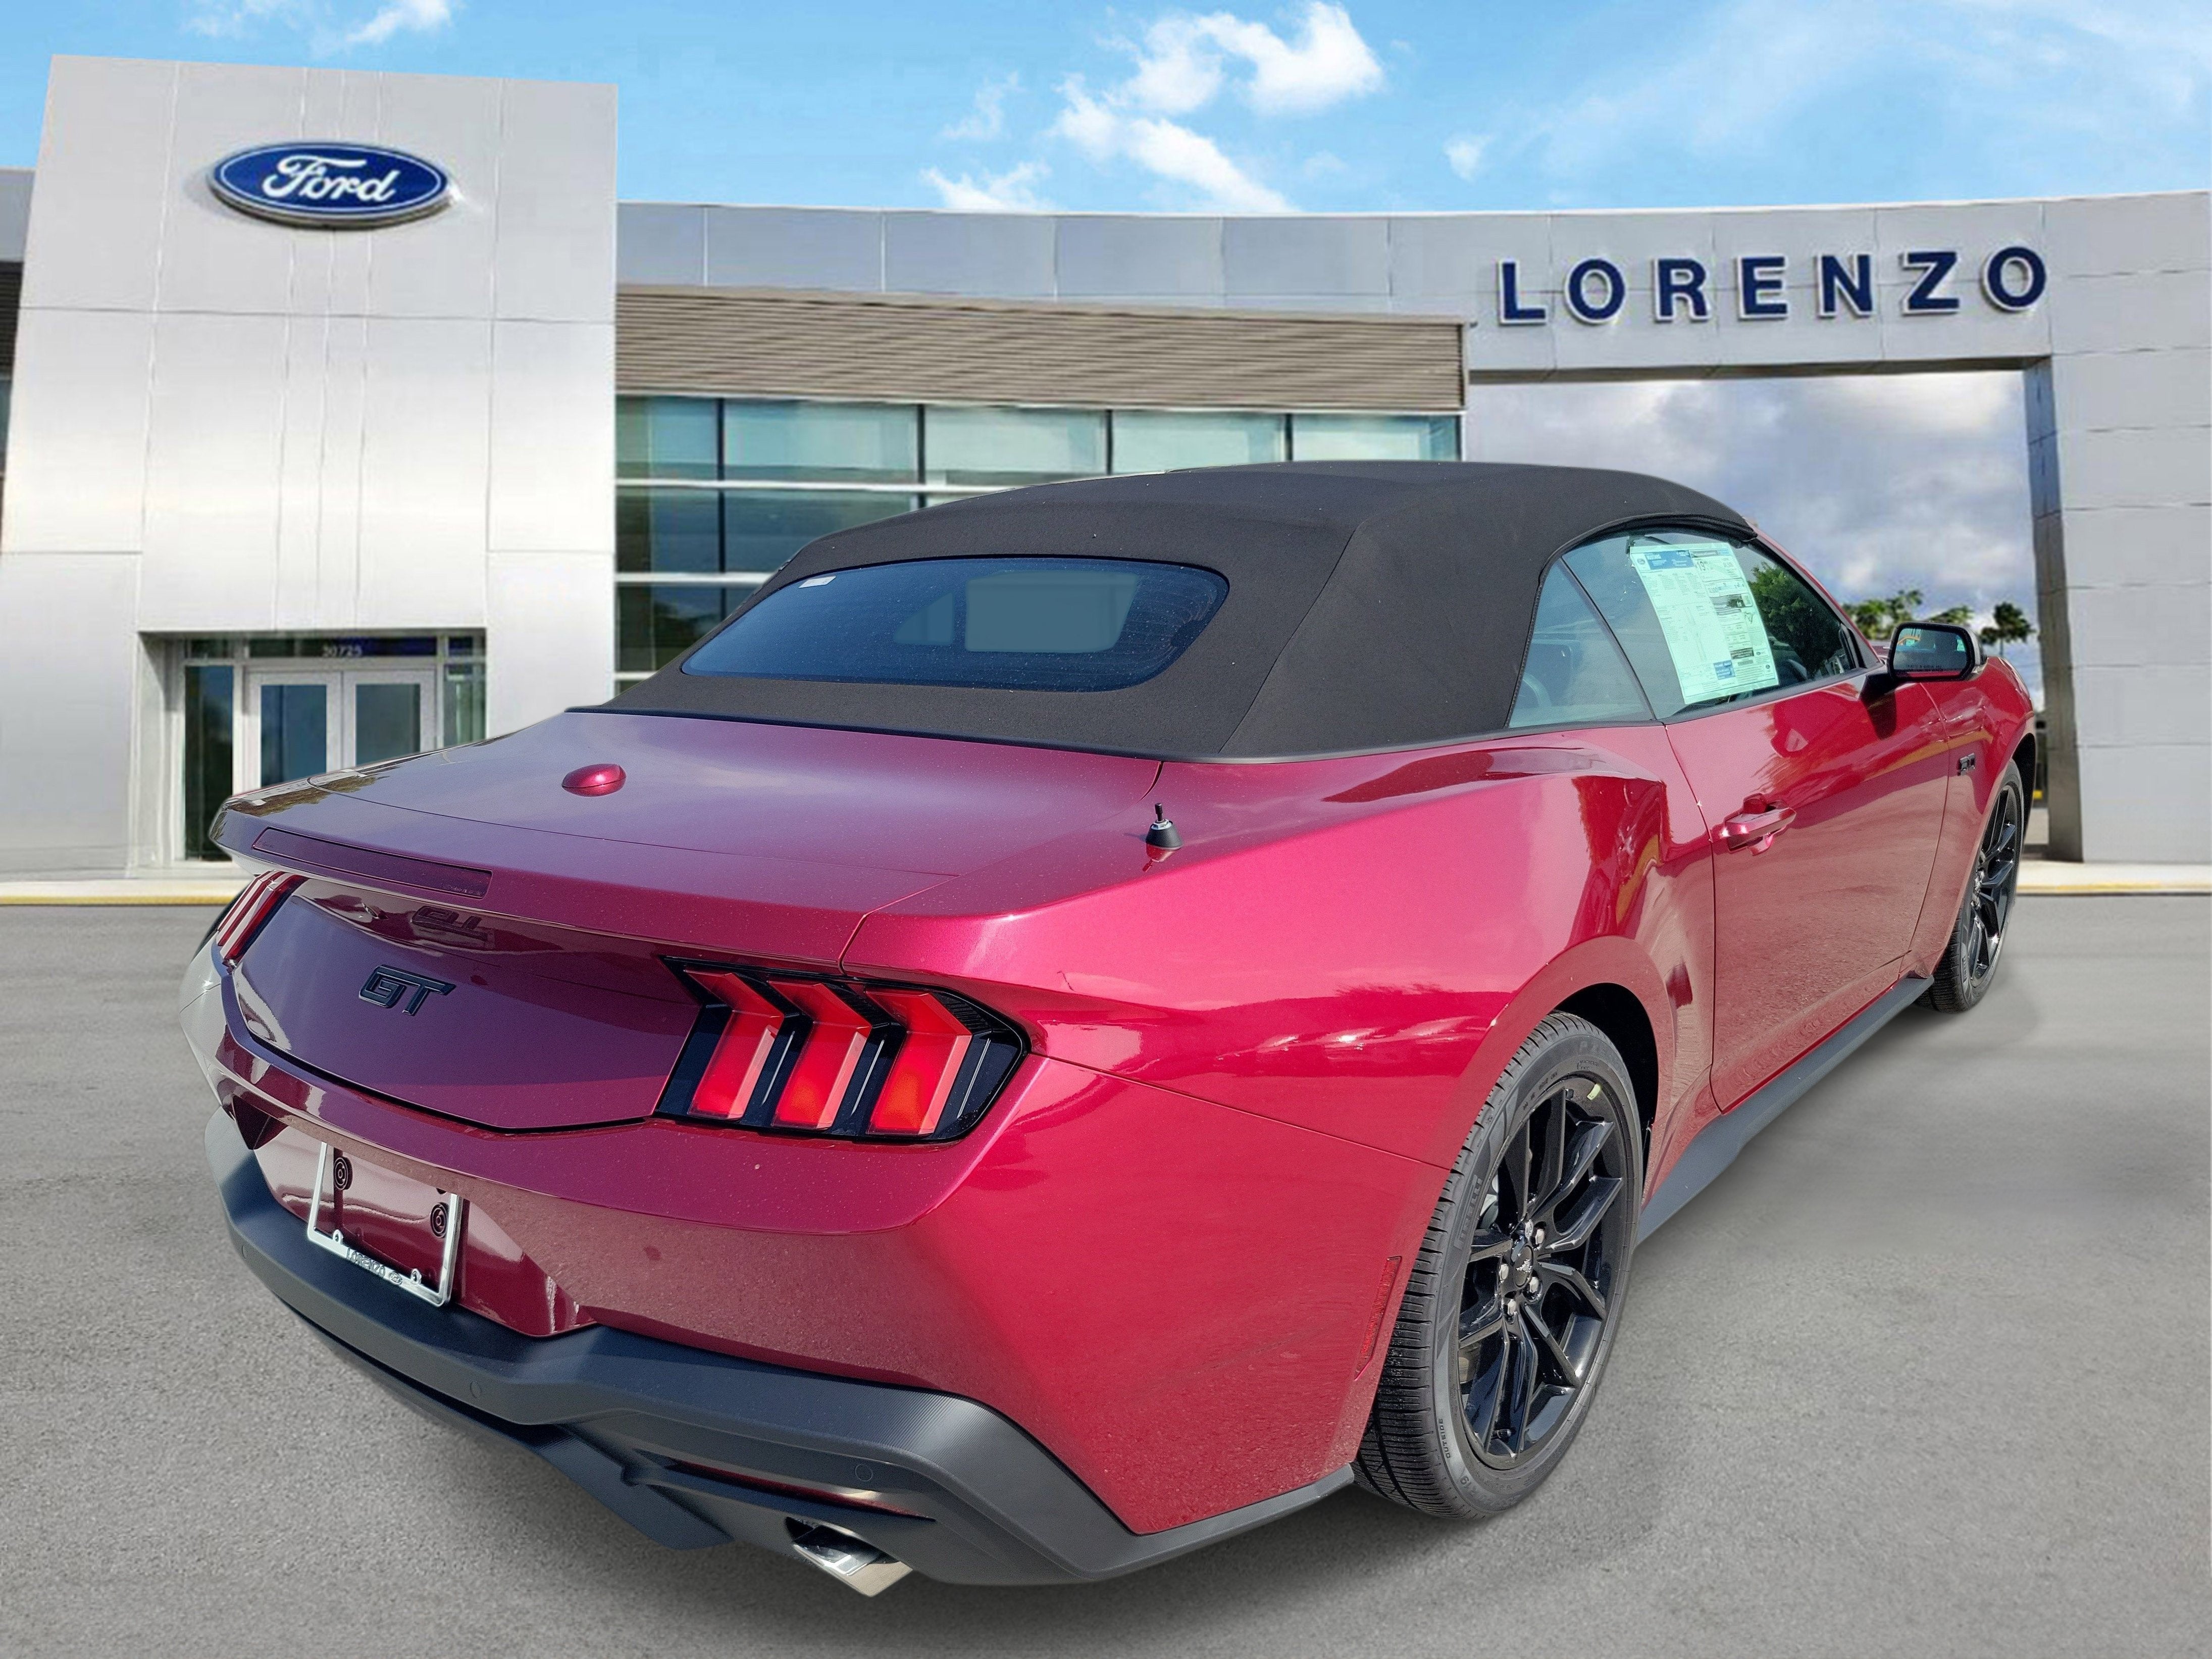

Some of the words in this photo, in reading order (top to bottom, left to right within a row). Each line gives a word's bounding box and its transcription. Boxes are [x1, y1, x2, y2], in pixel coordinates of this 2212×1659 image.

[262, 155, 401, 202] Ford
[1499, 247, 2046, 322] LORENZO
[359, 964, 455, 1016] GT
[1439, 1418, 1451, 1458] OUTSIDE
